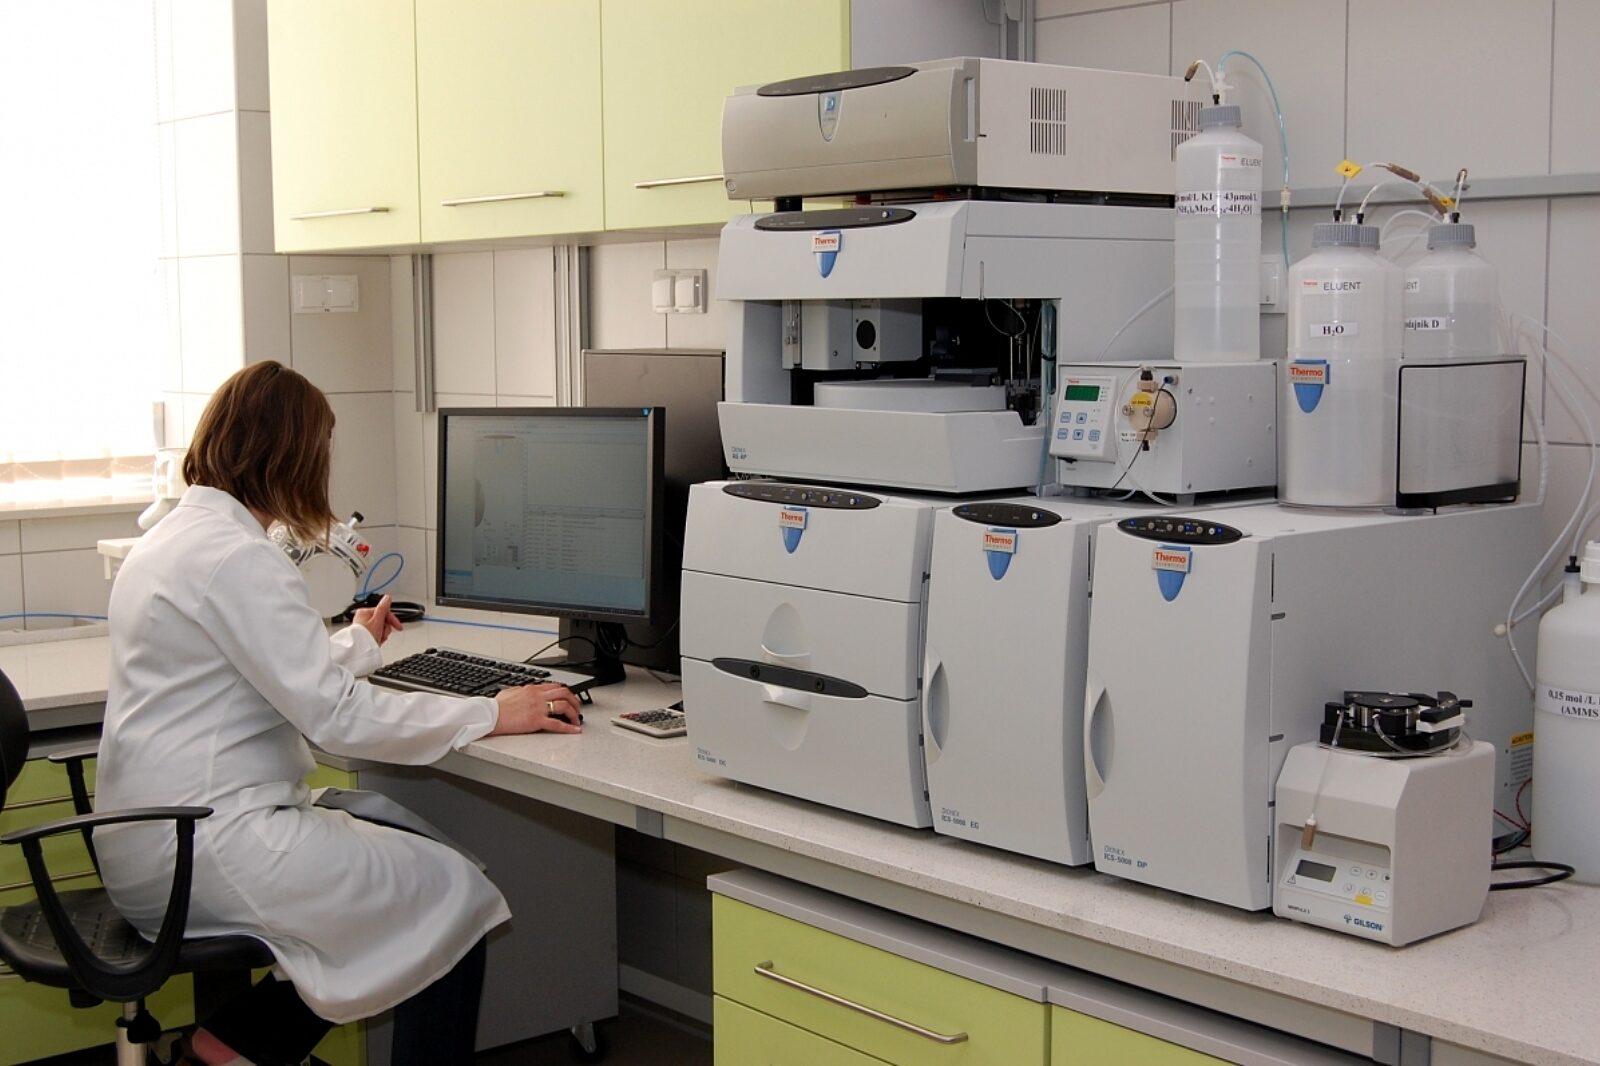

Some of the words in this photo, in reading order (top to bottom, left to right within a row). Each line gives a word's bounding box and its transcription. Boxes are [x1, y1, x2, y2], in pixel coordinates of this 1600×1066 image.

[1201, 192, 1213, 201] KI
[1323, 281, 1362, 291] ELUENT
[1431, 319, 1440, 329] D
[1290, 367, 1324, 377] Thermo
[780, 511, 804, 523] Thermo
[984, 533, 1013, 545] Thermo
[1154, 551, 1187, 564] Thermo
[1565, 694, 1583, 704] mol
[1561, 705, 1599, 718] (AMMS
[1353, 917, 1384, 932] GILSON
